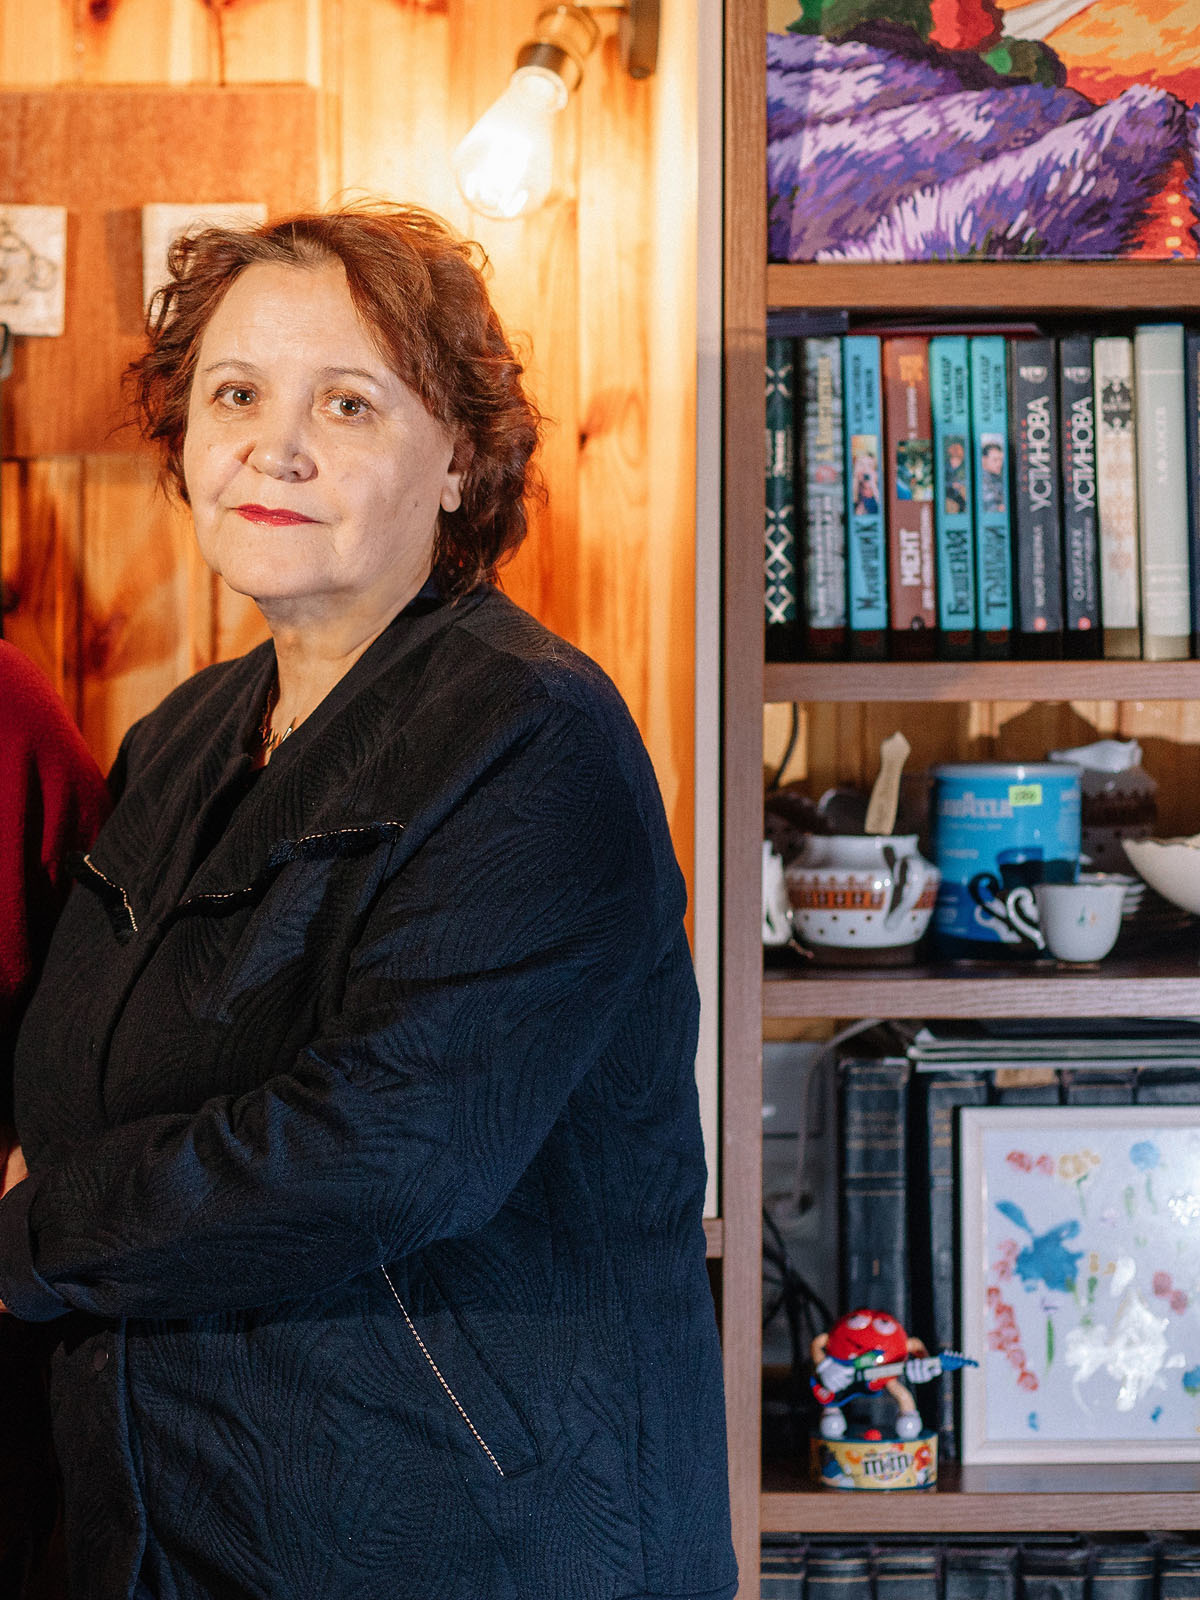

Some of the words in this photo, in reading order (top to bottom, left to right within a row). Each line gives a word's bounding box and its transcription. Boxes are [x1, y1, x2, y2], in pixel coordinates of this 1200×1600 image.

[1026, 395, 1052, 512] УСТИНОВА
[1071, 396, 1095, 512] УСТИНОВА
[899, 528, 921, 586] МЕНТ
